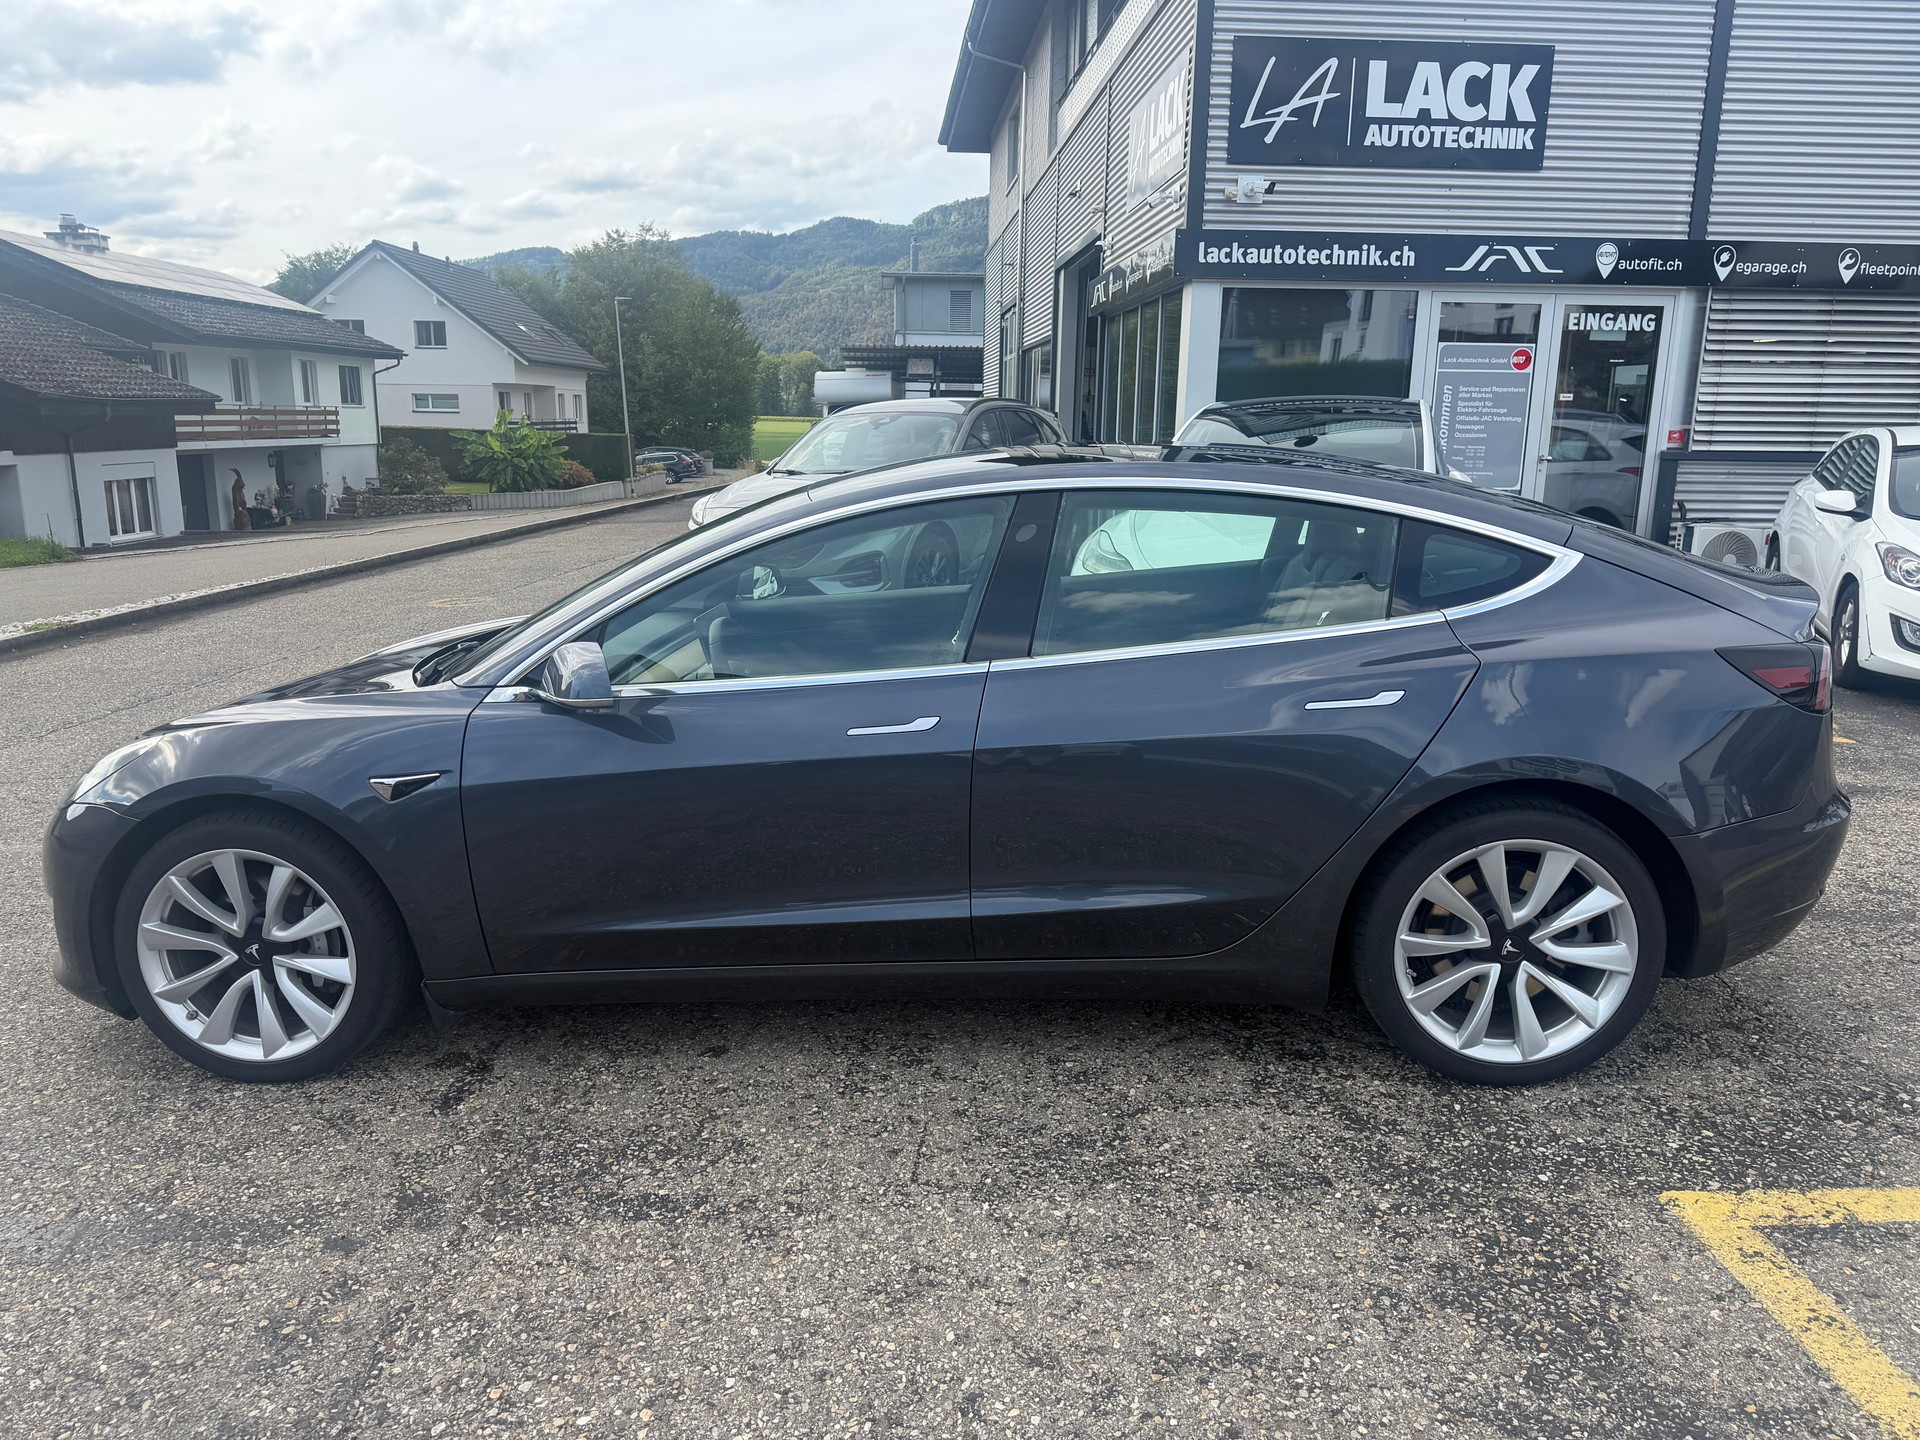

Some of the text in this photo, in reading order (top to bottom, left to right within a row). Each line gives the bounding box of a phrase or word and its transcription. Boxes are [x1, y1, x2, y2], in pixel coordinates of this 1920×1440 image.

[1365, 59, 1541, 122] LACK
[1149, 67, 1186, 154] LACK
[1363, 124, 1536, 150] AUTOTECHNIK
[1198, 241, 1416, 267] lackautotechnik.ch
[1445, 245, 1564, 273] JAC
[1618, 258, 1683, 271] autofit.ch
[1736, 261, 1807, 276] egarage.ch
[1568, 312, 1657, 332] EINGANG
[1439, 385, 1453, 453] kommen
